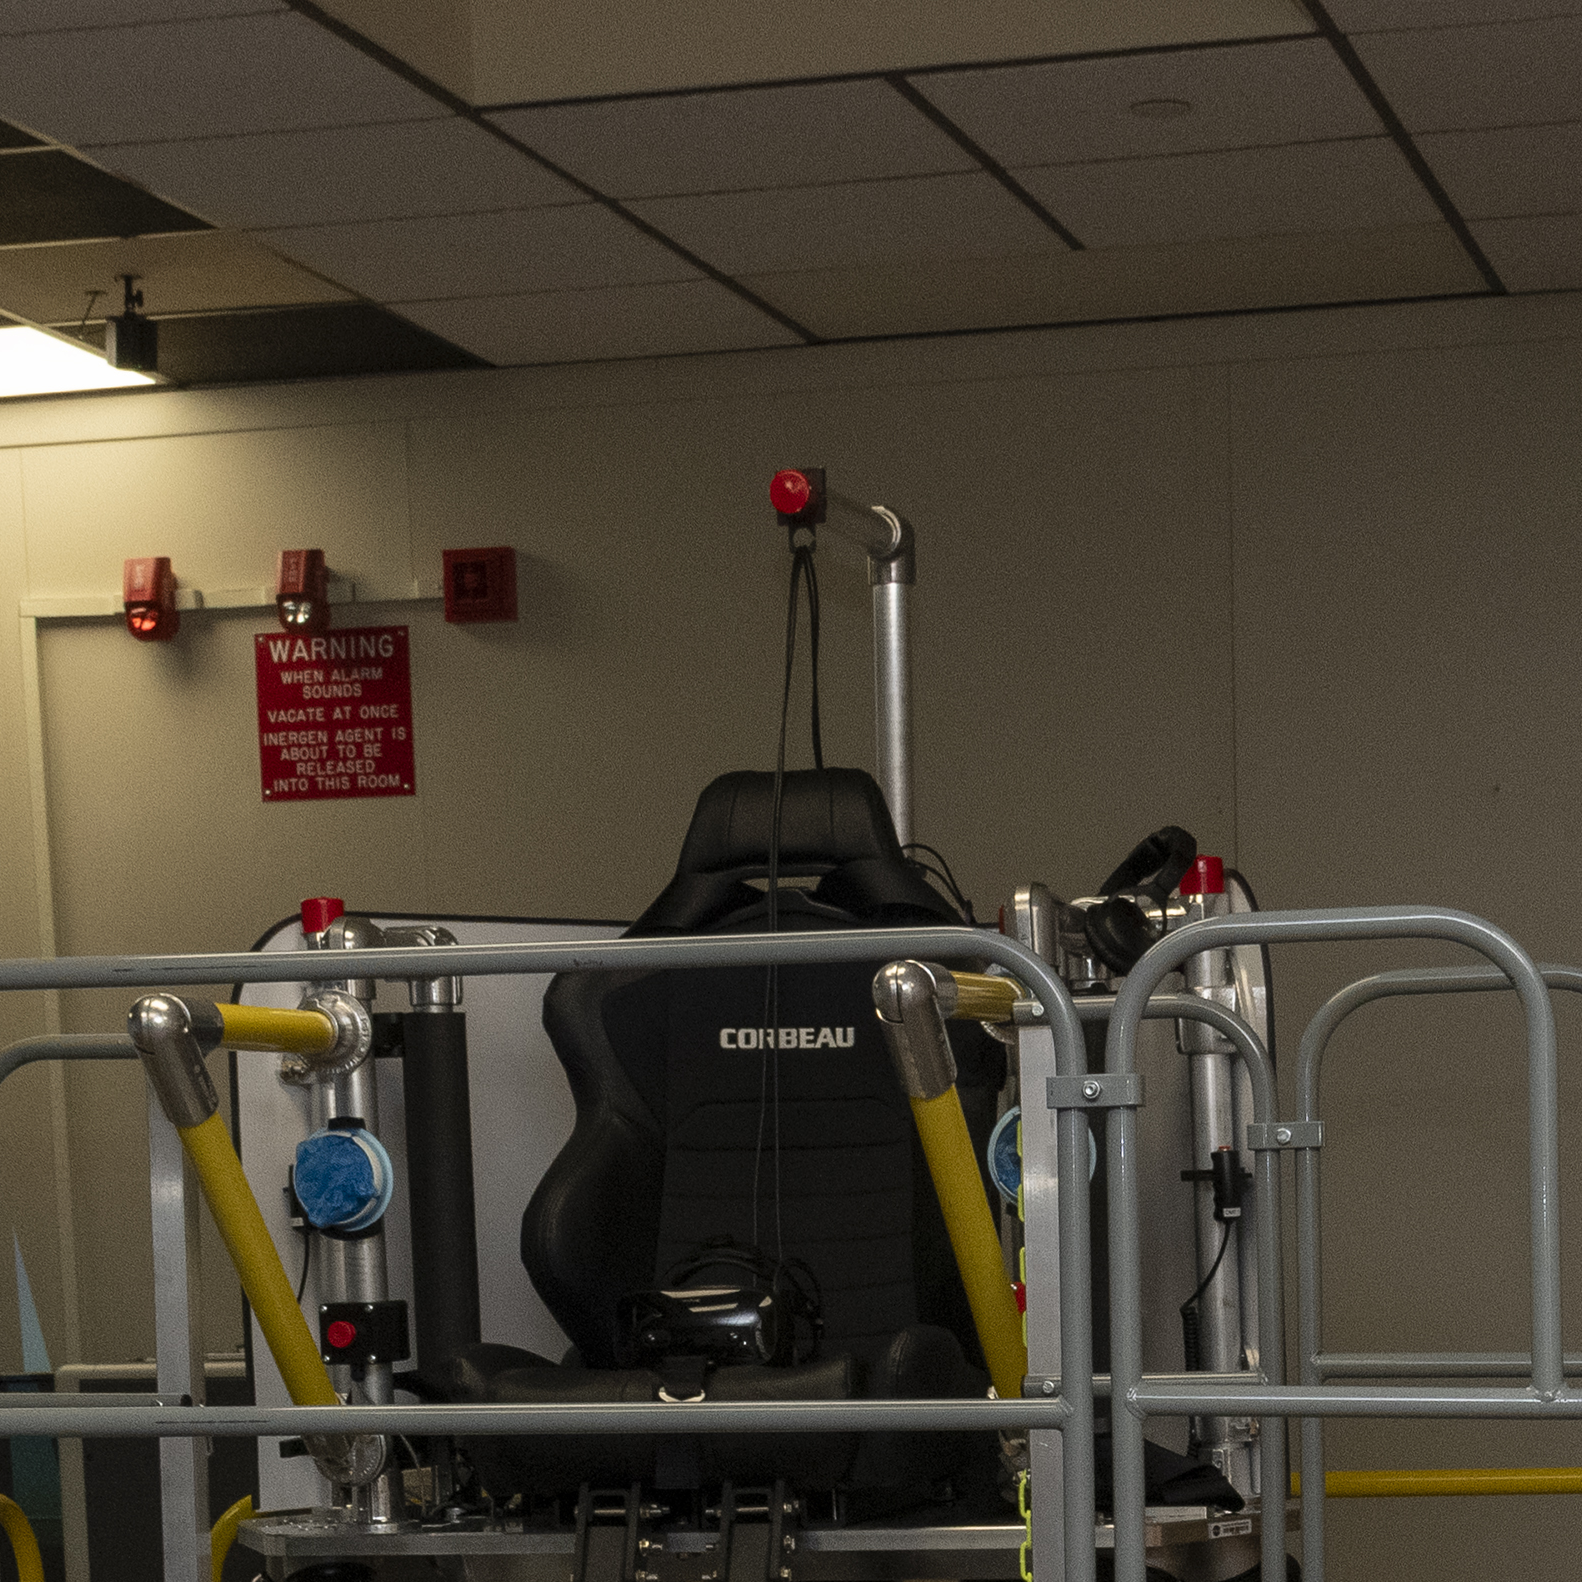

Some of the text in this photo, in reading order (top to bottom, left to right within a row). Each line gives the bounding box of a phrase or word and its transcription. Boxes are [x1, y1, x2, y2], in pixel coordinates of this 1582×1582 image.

[269, 635, 394, 663] WARNING
[280, 668, 383, 684] WHEN ALARM
[302, 684, 363, 700] SOUNDS
[268, 705, 399, 723] VACATE AT ONCE
[263, 727, 406, 746] INERGEN AGENT IS
[280, 744, 383, 761] ABOUT TO BE
[296, 761, 376, 776] RELEASED
[273, 775, 401, 792] INTO THIS ROOM
[720, 1027, 855, 1049] CORBEAU
